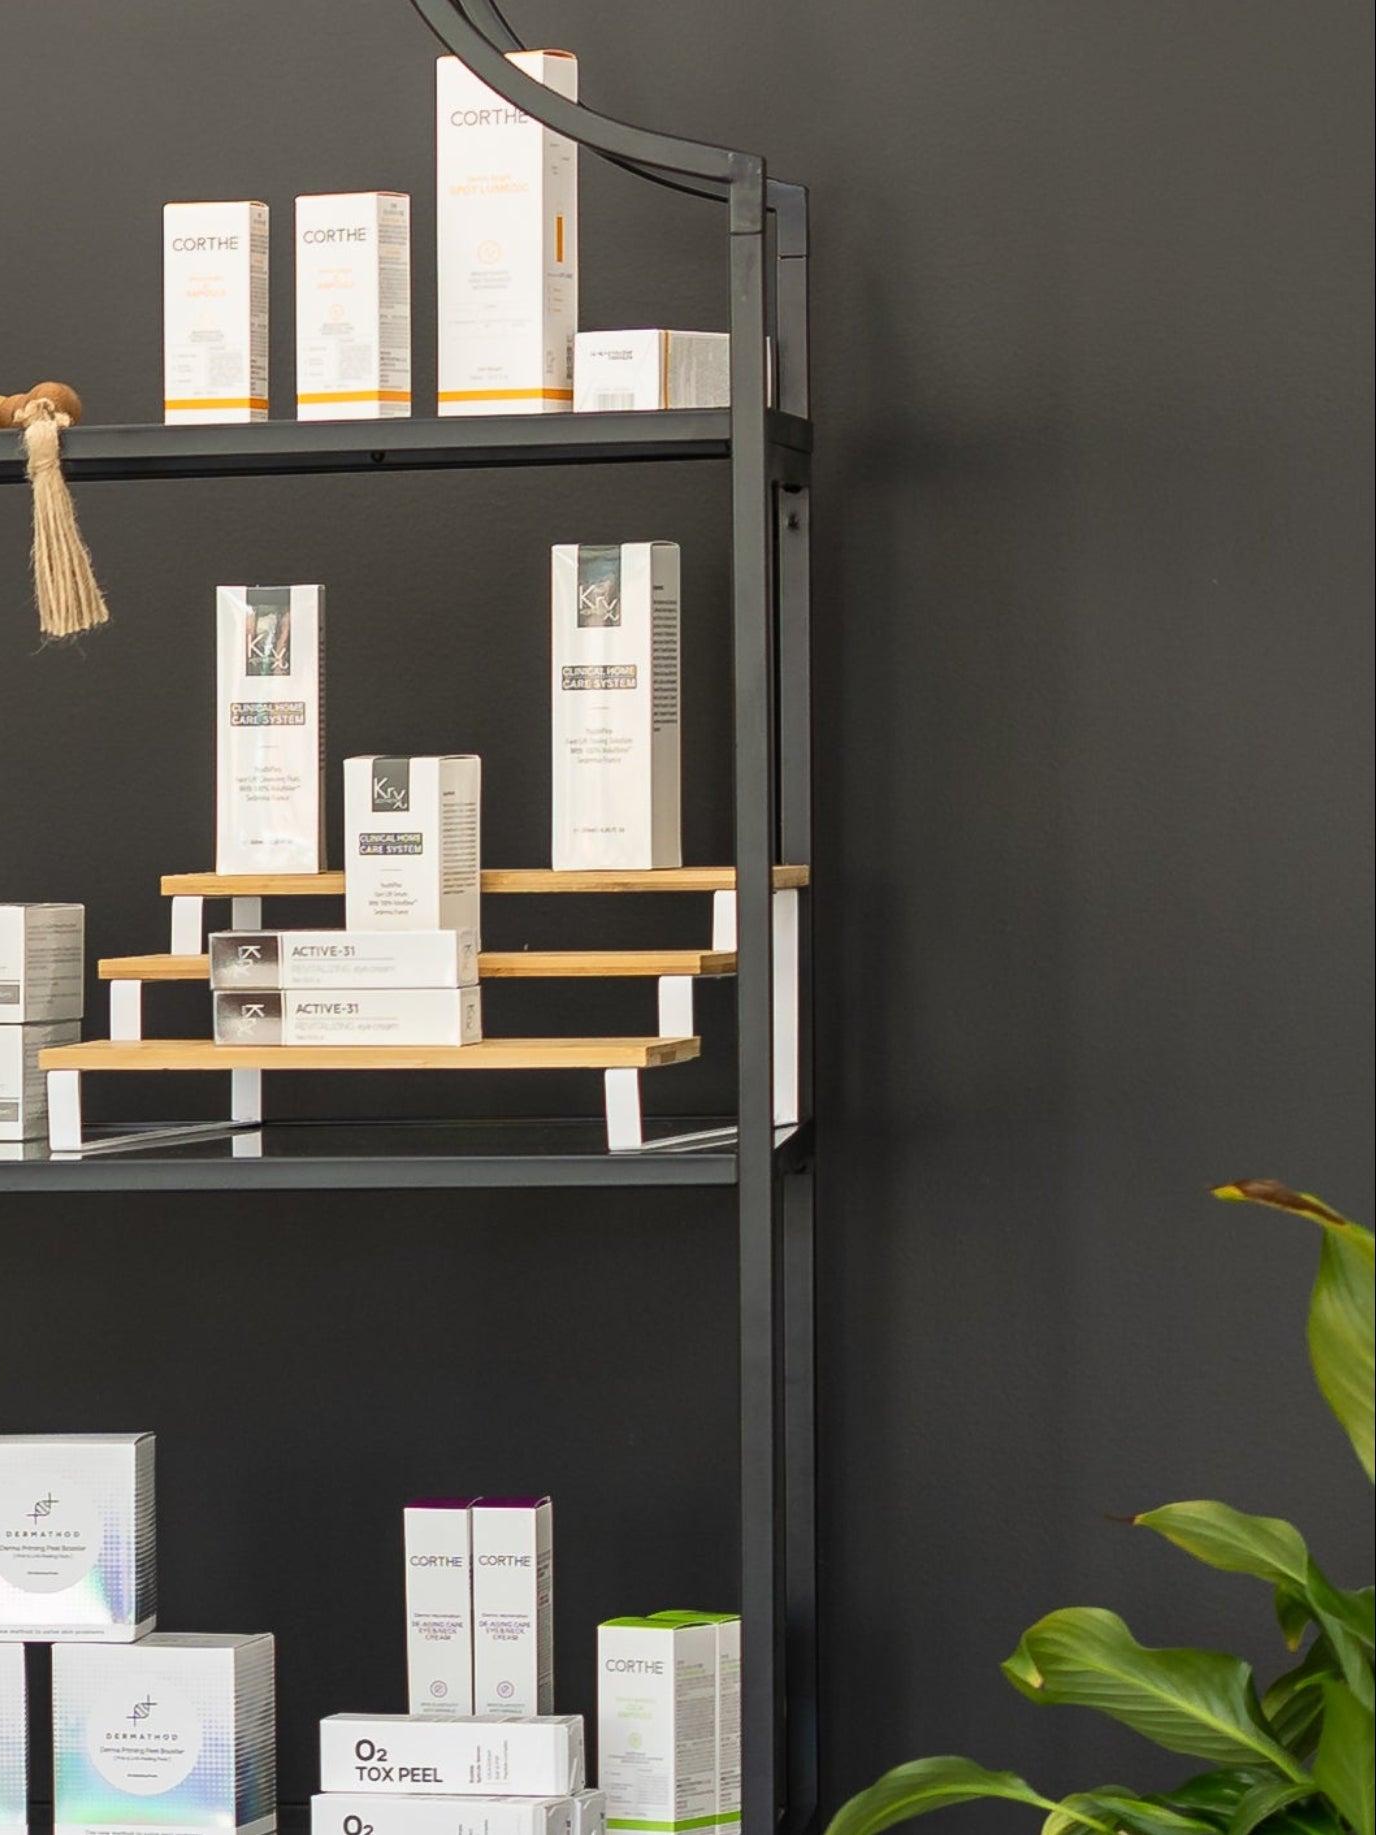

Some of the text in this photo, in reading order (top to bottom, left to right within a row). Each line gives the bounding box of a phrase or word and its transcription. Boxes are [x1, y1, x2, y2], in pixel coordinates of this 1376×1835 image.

[303, 227, 367, 245] CORTHE
[172, 235, 239, 252] CORTHE
[562, 665, 636, 677] CLINICAL HOME
[562, 677, 636, 690] CARE SYSTEM
[231, 702, 304, 713] CLINICAL HOME
[231, 714, 305, 725] CARE SYSTEM
[360, 833, 421, 842] CLINICAL HOME
[360, 844, 422, 854] CARE SYSTEM
[292, 945, 356, 957] ACTIVE-31
[295, 1003, 359, 1015] ACTIVE-31
[5, 1530, 81, 1538] DERMATHOD
[409, 1555, 464, 1567] CORTHE
[478, 1555, 532, 1567] CORTHE
[605, 1658, 665, 1675] CORTHE
[105, 1732, 179, 1741] DERMATHOD
[355, 1766, 443, 1783] TOX PEEL
